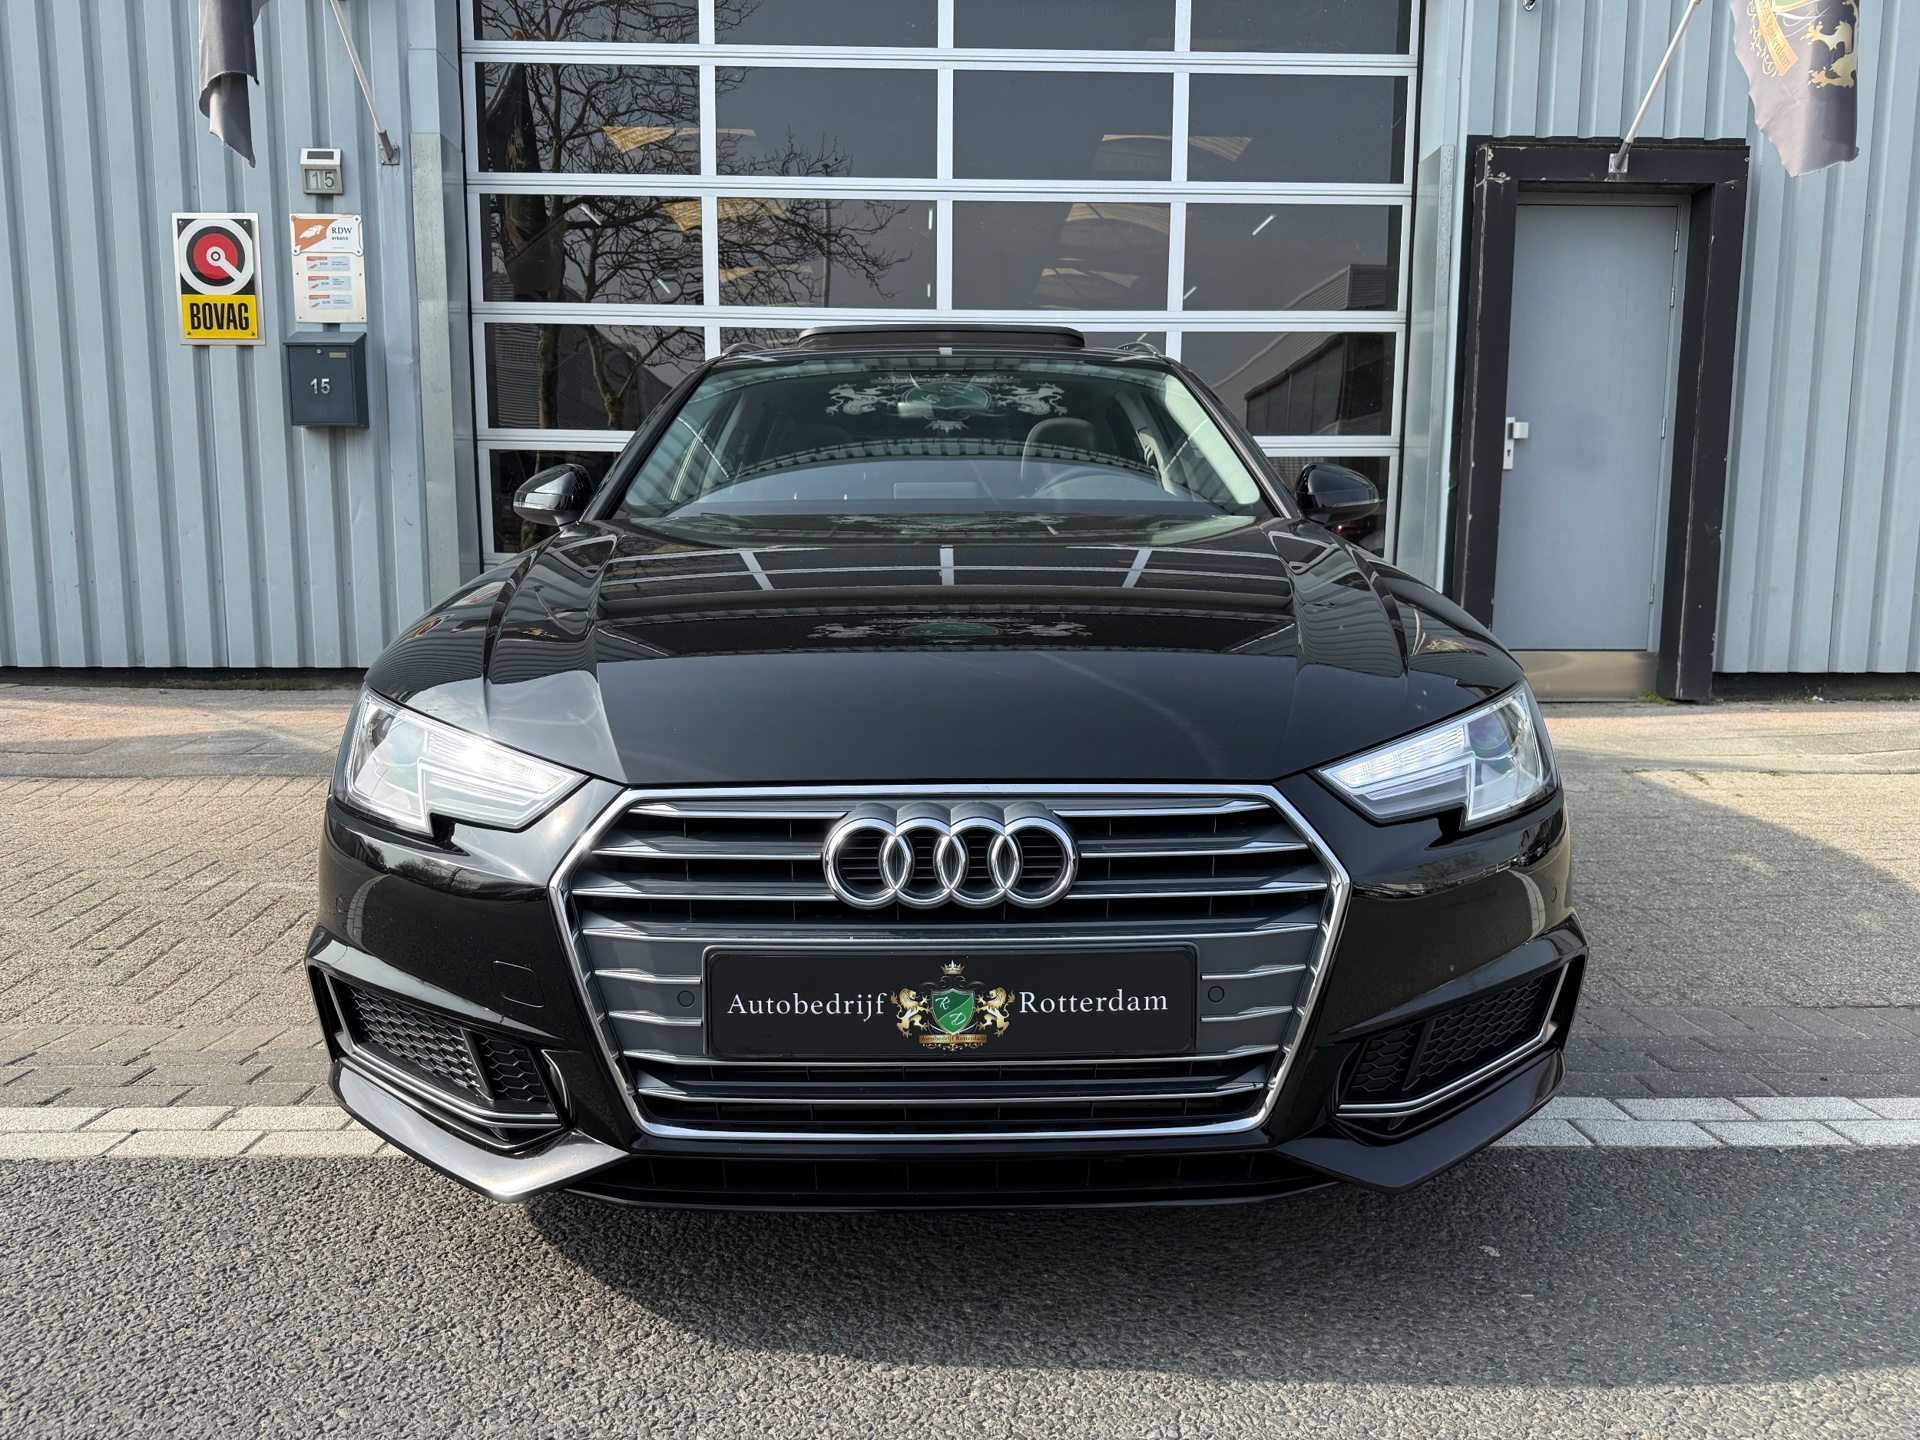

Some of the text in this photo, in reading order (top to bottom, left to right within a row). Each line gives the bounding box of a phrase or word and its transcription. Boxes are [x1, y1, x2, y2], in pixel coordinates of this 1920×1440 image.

[311, 170, 335, 189] 15
[331, 226, 353, 234] RDW
[189, 302, 250, 331] BOVAG
[310, 377, 331, 395] 15
[727, 988, 1169, 1022] Autobedrijf Rotterdam
